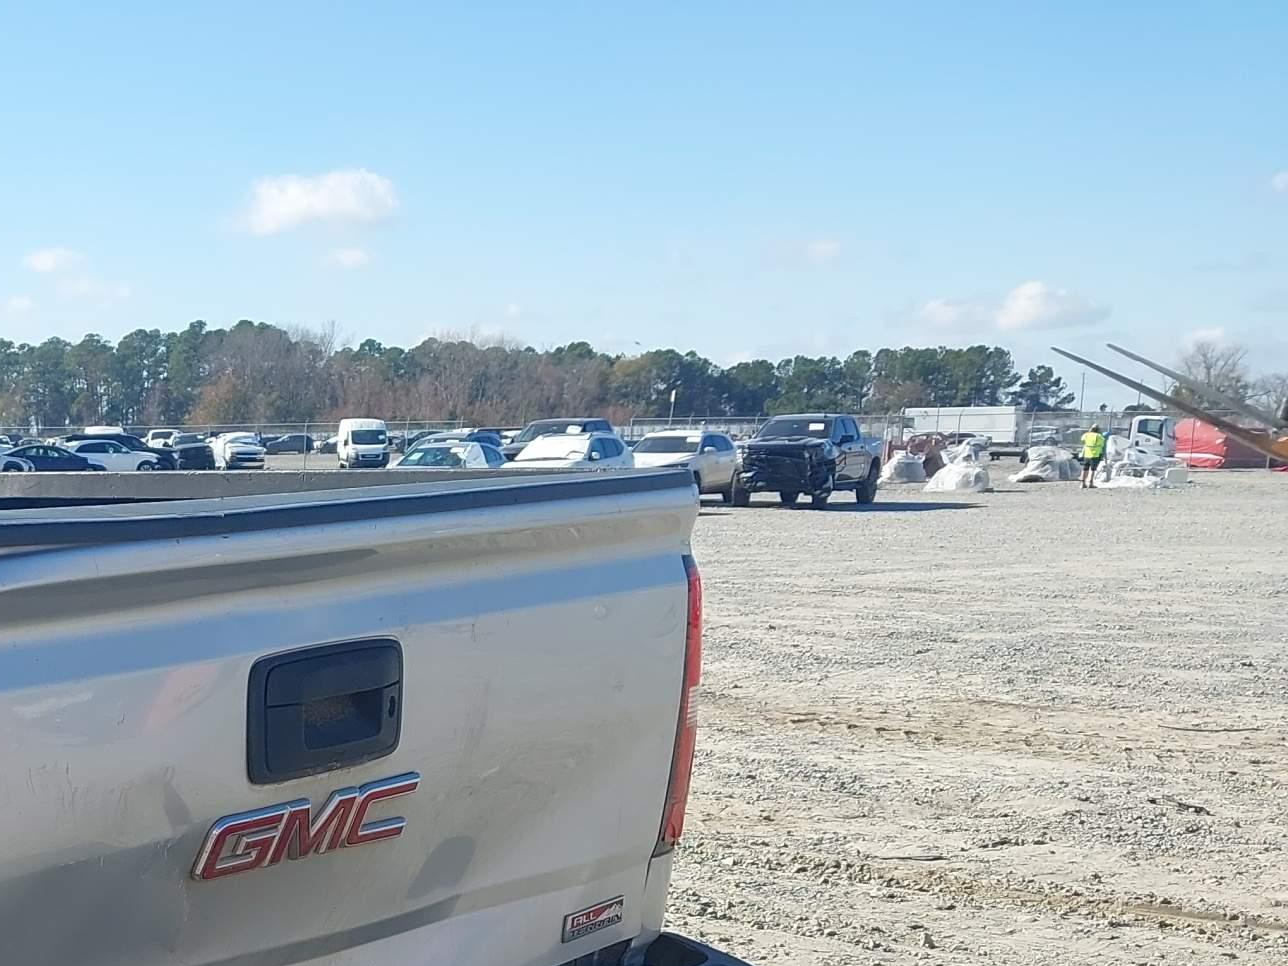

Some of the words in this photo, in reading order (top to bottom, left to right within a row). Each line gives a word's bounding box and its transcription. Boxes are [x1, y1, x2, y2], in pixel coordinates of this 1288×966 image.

[193, 770, 421, 881] GMC
[570, 911, 623, 937] TERRAIN
[573, 911, 597, 927] ALL
